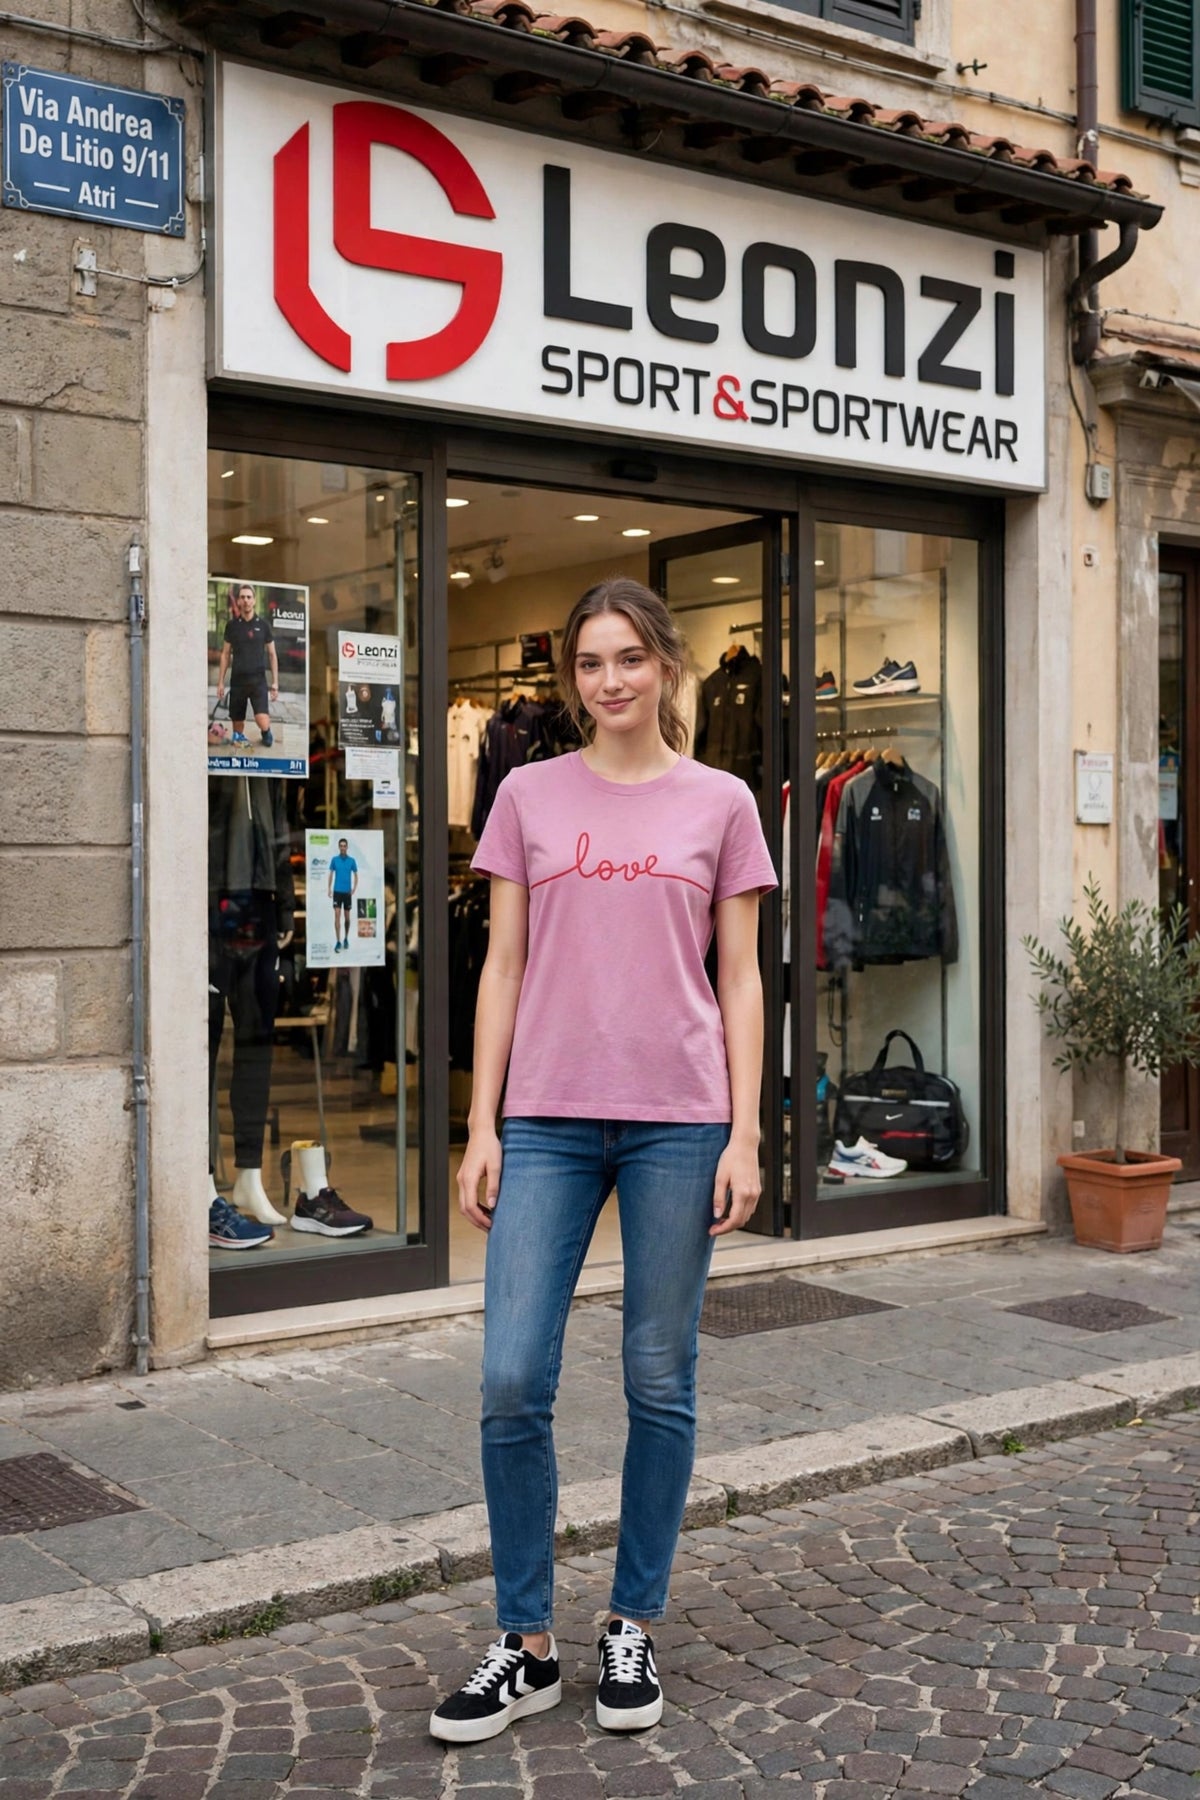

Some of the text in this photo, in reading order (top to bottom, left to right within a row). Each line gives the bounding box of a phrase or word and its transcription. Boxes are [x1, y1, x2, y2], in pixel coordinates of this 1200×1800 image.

[19, 85, 153, 140] Via Andrea
[19, 122, 169, 181] De Litio 9/11
[78, 181, 116, 210] Atri
[543, 163, 1015, 397] Leonzi
[541, 344, 1019, 463] SPORT&SPORTWEAR
[357, 644, 398, 658] Leonzi
[576, 832, 658, 881] love
